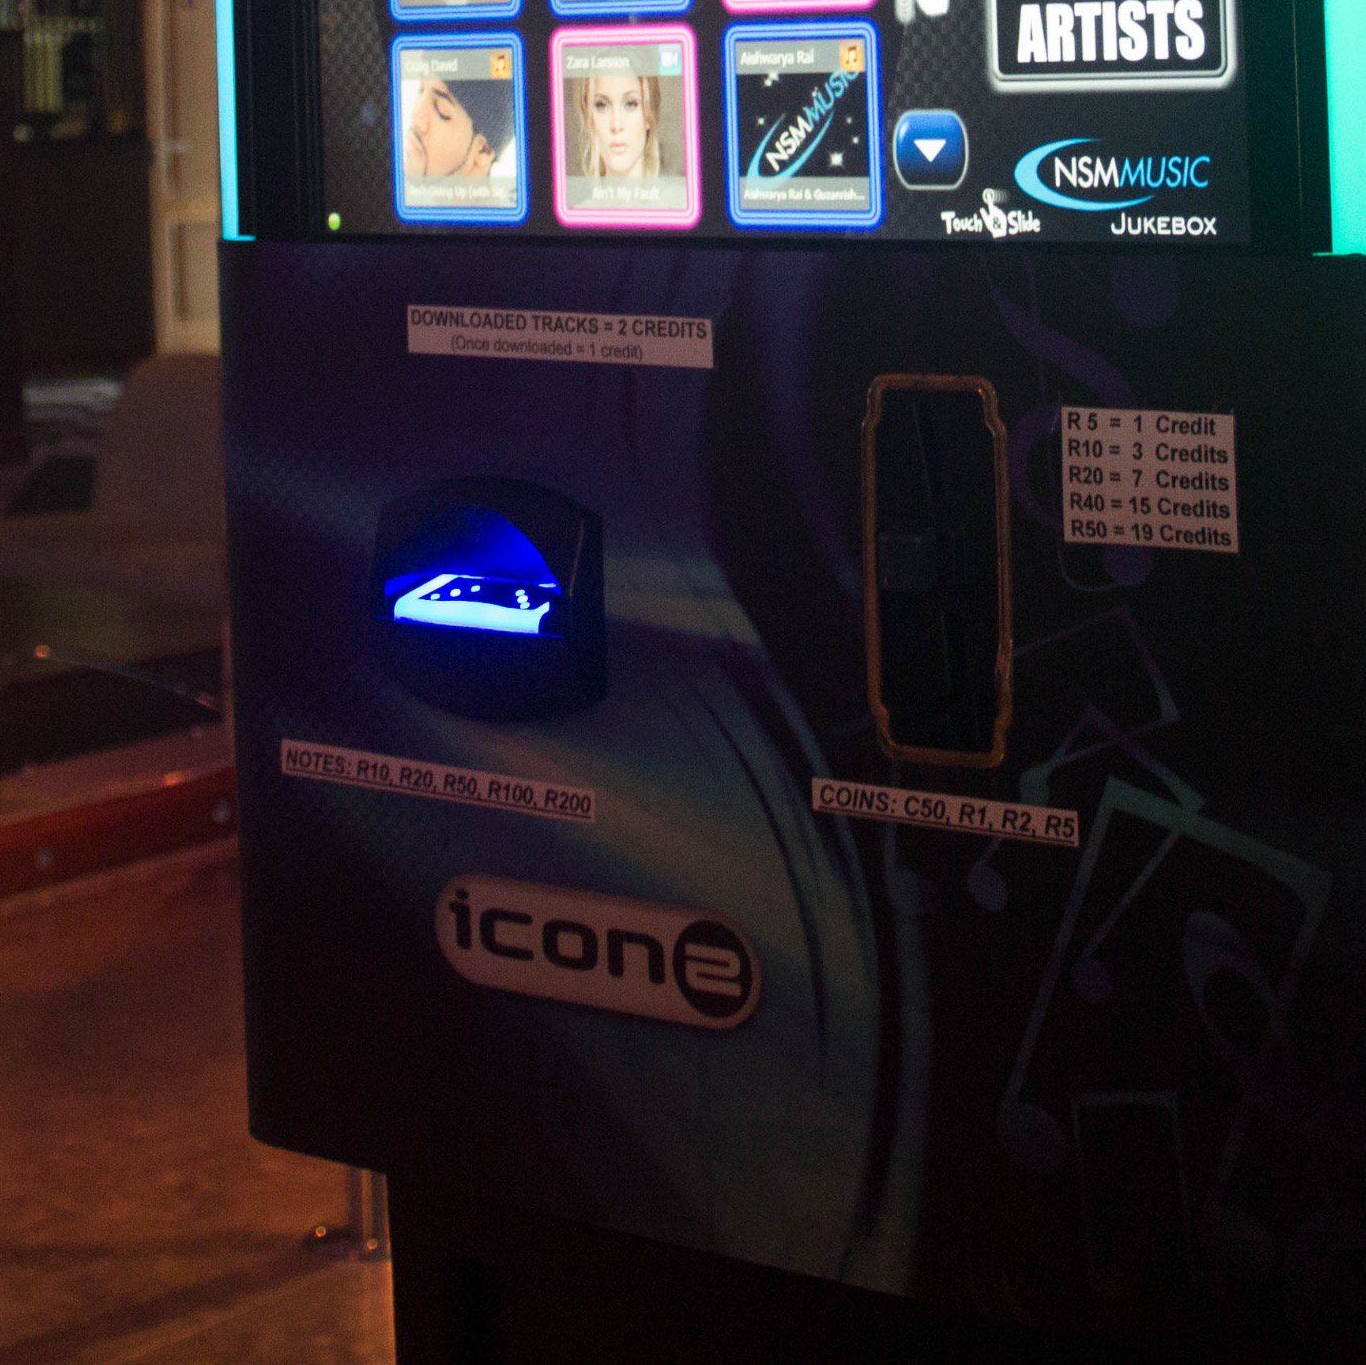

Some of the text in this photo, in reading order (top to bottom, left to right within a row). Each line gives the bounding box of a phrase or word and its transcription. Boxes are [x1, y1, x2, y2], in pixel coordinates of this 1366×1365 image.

[1054, 154, 1211, 189] NSMMUSIC
[940, 209, 984, 235] Touch
[1006, 209, 1042, 234] Slide
[1110, 212, 1217, 236] JUKEBOX
[410, 308, 528, 332] DOWNLOADED
[531, 314, 599, 335] TRACKS
[618, 319, 628, 335] 2
[631, 319, 708, 340] CREDITS
[450, 335, 490, 354] (Once
[493, 336, 573, 357] downloaded
[600, 342, 644, 363] credit)
[1067, 411, 1081, 430] R
[1087, 413, 1098, 431] 5
[1133, 415, 1143, 433] 1
[1155, 415, 1216, 436] Credit
[1067, 439, 1103, 458] R10
[1132, 442, 1143, 461] 3
[1155, 442, 1229, 464] Credits
[1068, 465, 1104, 485] R20
[1132, 469, 1143, 488] 7
[1156, 469, 1230, 492] Credits
[1069, 492, 1105, 512] R40
[1129, 496, 1152, 515] 15
[1157, 497, 1231, 520] Credits
[1071, 519, 1107, 538] R50
[1131, 523, 1153, 542] 19
[1159, 524, 1232, 547] Credits
[285, 747, 592, 815] NOTES: R10, R20, R50, R100, R200
[819, 783, 1075, 839] COINS: C50, R1, R2, R5
